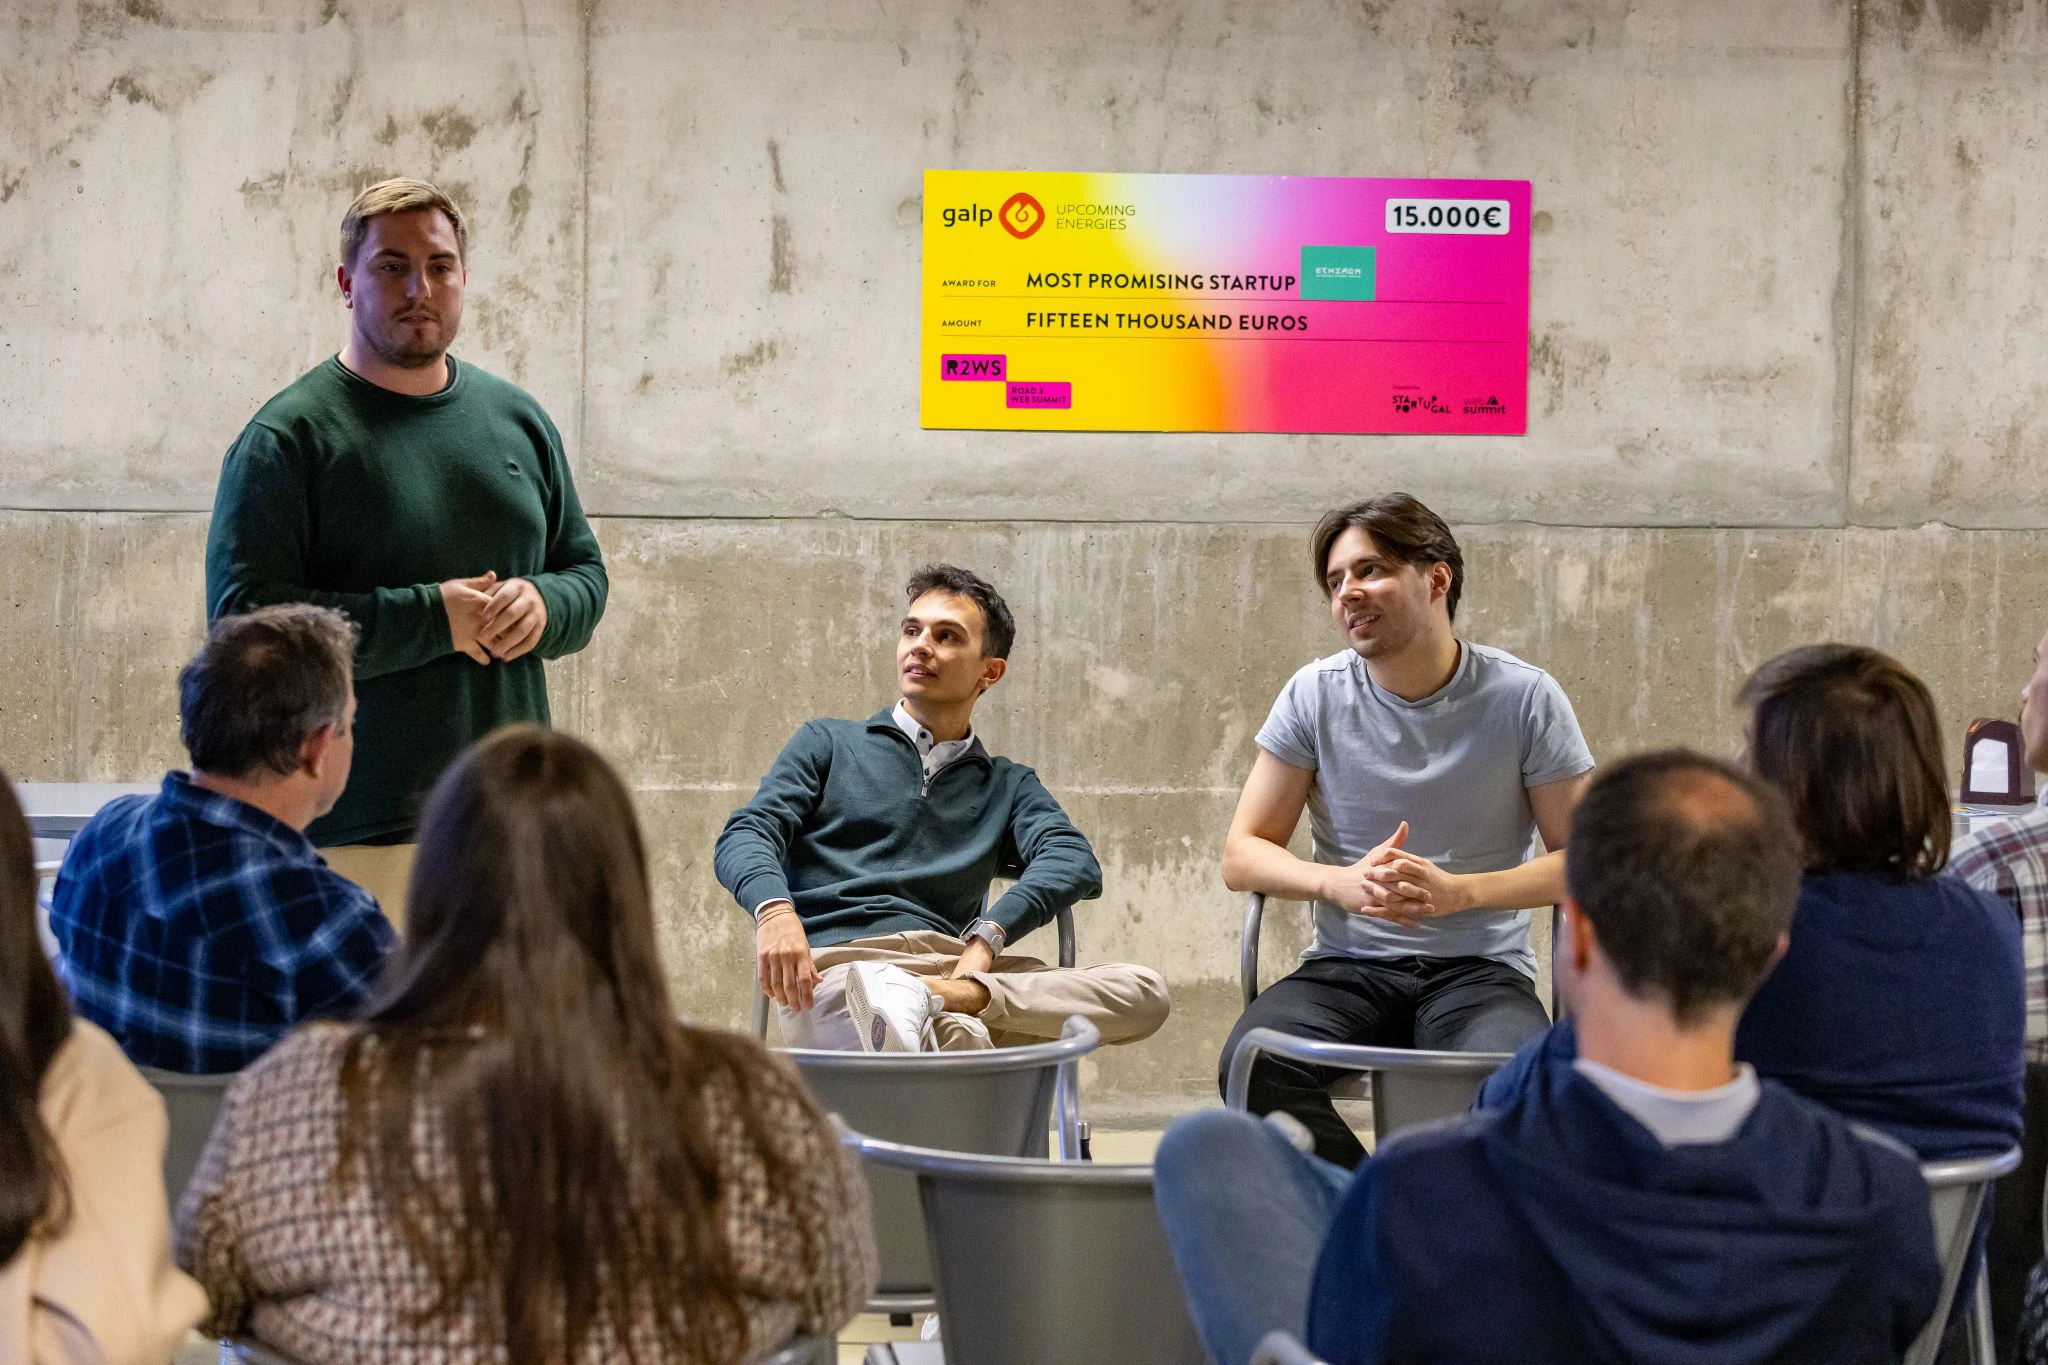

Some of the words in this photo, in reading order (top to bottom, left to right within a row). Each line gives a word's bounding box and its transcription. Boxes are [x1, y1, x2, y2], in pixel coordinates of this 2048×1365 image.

[942, 203, 993, 227] galp
[1056, 204, 1136, 217] UPCOMING
[1393, 205, 1502, 228] 15.000€
[1056, 218, 1127, 230] ENERGIES
[942, 279, 976, 288] AWARD
[977, 280, 997, 288] FOR
[1026, 272, 1082, 288] MOST
[1088, 273, 1204, 290] PROMISING
[1209, 274, 1296, 291] STARTUP
[941, 320, 983, 328] AMOUNT
[1026, 312, 1110, 329] FIFTEEN
[1116, 314, 1233, 331] THOUSAND
[1239, 315, 1309, 331] EUROS
[946, 359, 1002, 376] R2WS
[1011, 387, 1037, 395] ROAD
[1038, 387, 1044, 395] 2
[1011, 396, 1030, 404] WEB
[1032, 396, 1067, 404] SUMMIT
[1463, 405, 1506, 414] summit
